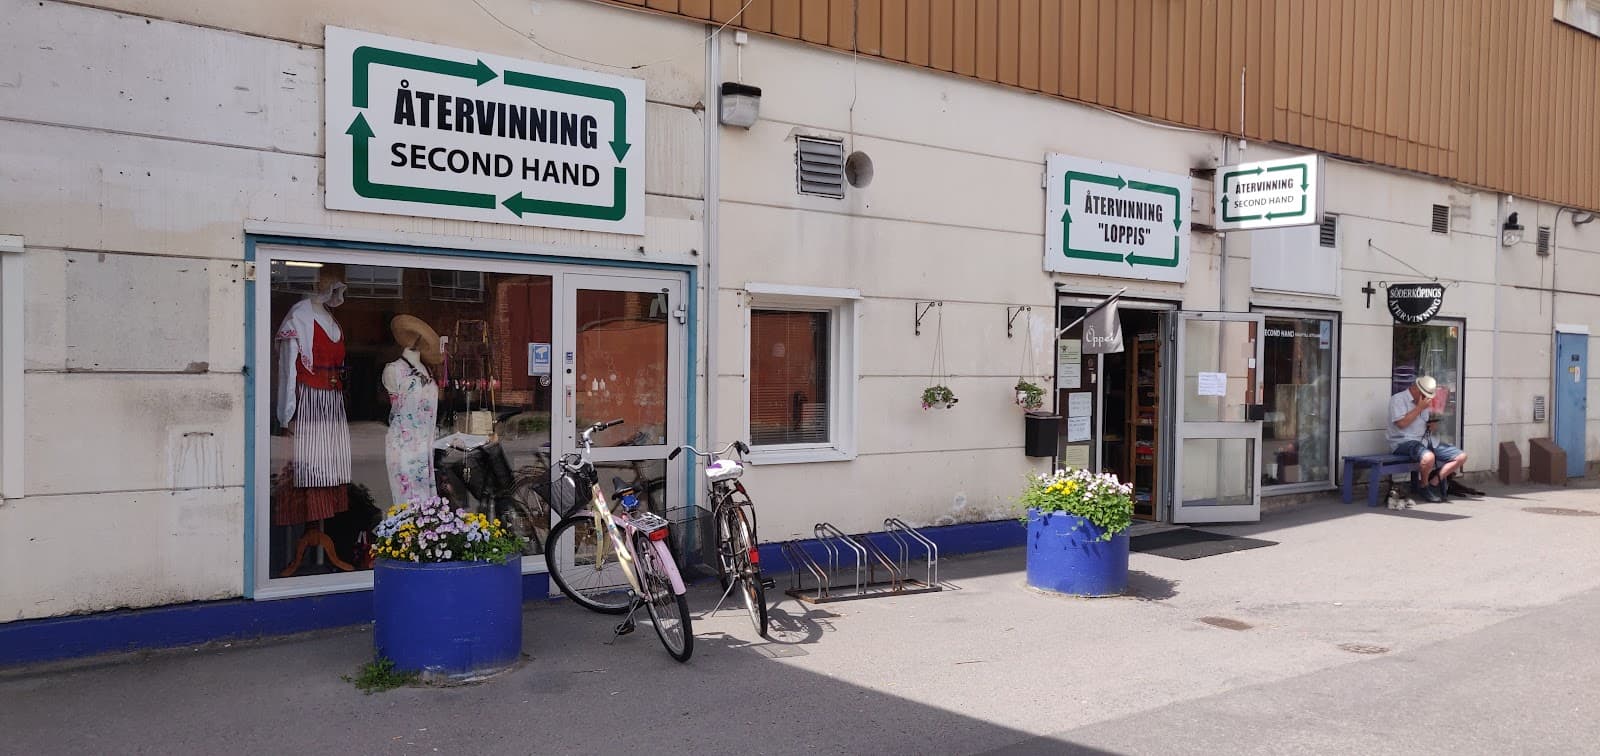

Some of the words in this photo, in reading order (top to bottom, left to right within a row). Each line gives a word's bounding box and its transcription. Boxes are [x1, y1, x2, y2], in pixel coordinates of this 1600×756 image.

[393, 79, 599, 150] ÅTERVINNING
[390, 142, 514, 178] SECOND
[521, 157, 600, 188] HAND
[1084, 189, 1163, 223] ÅTERVINNING
[1234, 198, 1267, 209] SECOND
[1269, 195, 1294, 205] HAND
[1098, 222, 1151, 246] "LOPPIS"
[1390, 287, 1441, 298] SÖDERKÖPINGS
